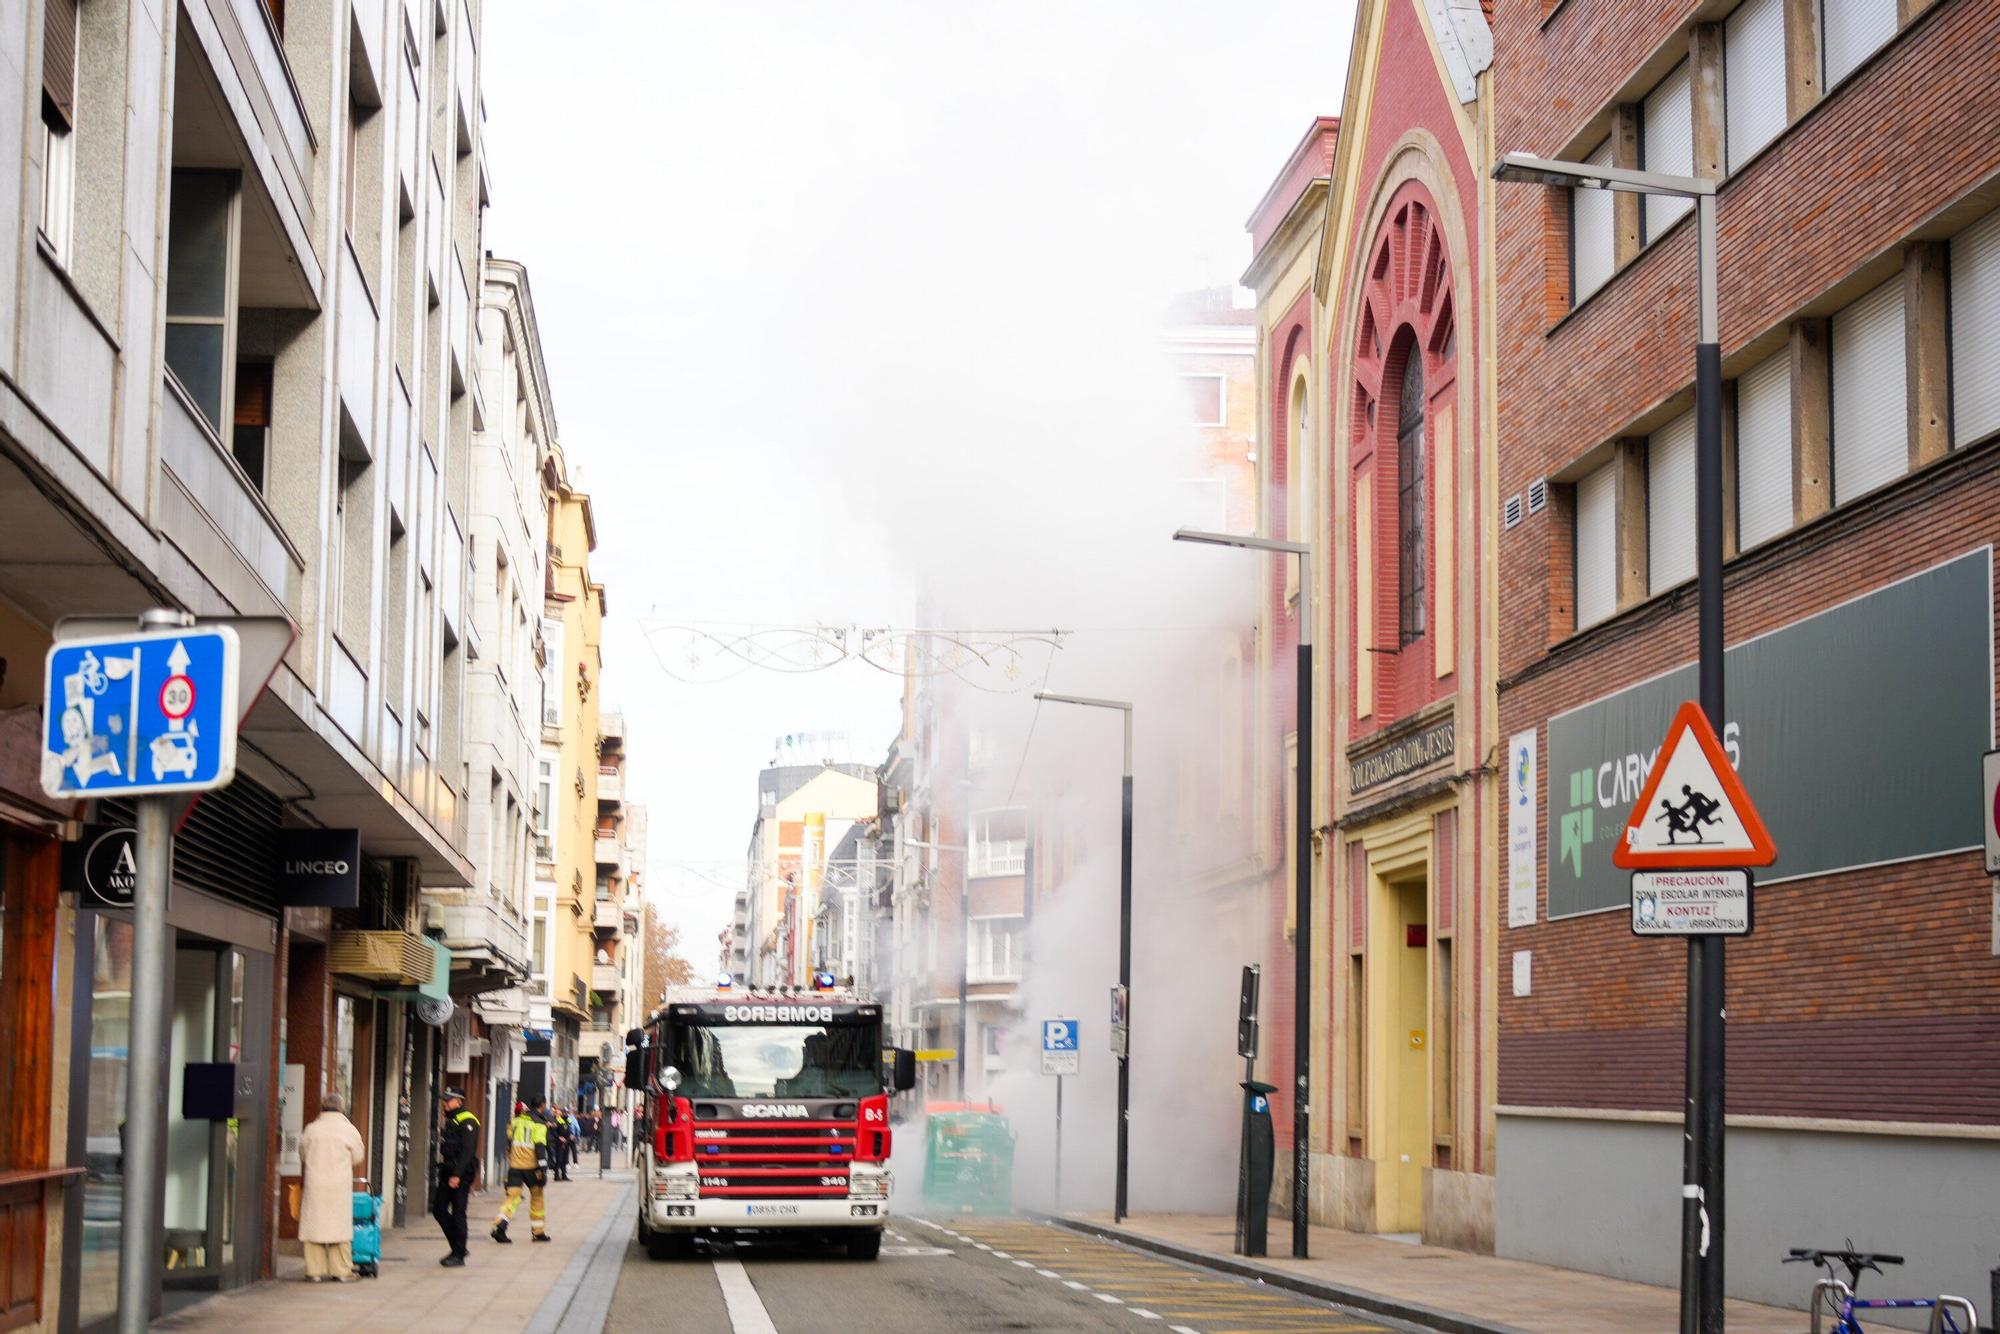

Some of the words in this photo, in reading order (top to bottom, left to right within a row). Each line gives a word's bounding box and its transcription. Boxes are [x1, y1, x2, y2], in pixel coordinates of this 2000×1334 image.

[168, 688, 188, 706] 30
[112, 841, 137, 874] A
[286, 860, 349, 874] LINCEO
[1635, 890, 1657, 901] ZONA
[1661, 889, 1699, 900] ESCOLAR
[1703, 888, 1745, 900] INTENSIVA
[1047, 1022, 1069, 1049] P
[742, 1104, 809, 1118] SCANIA
[1255, 1096, 1266, 1112] P
[821, 1176, 847, 1187] 340
